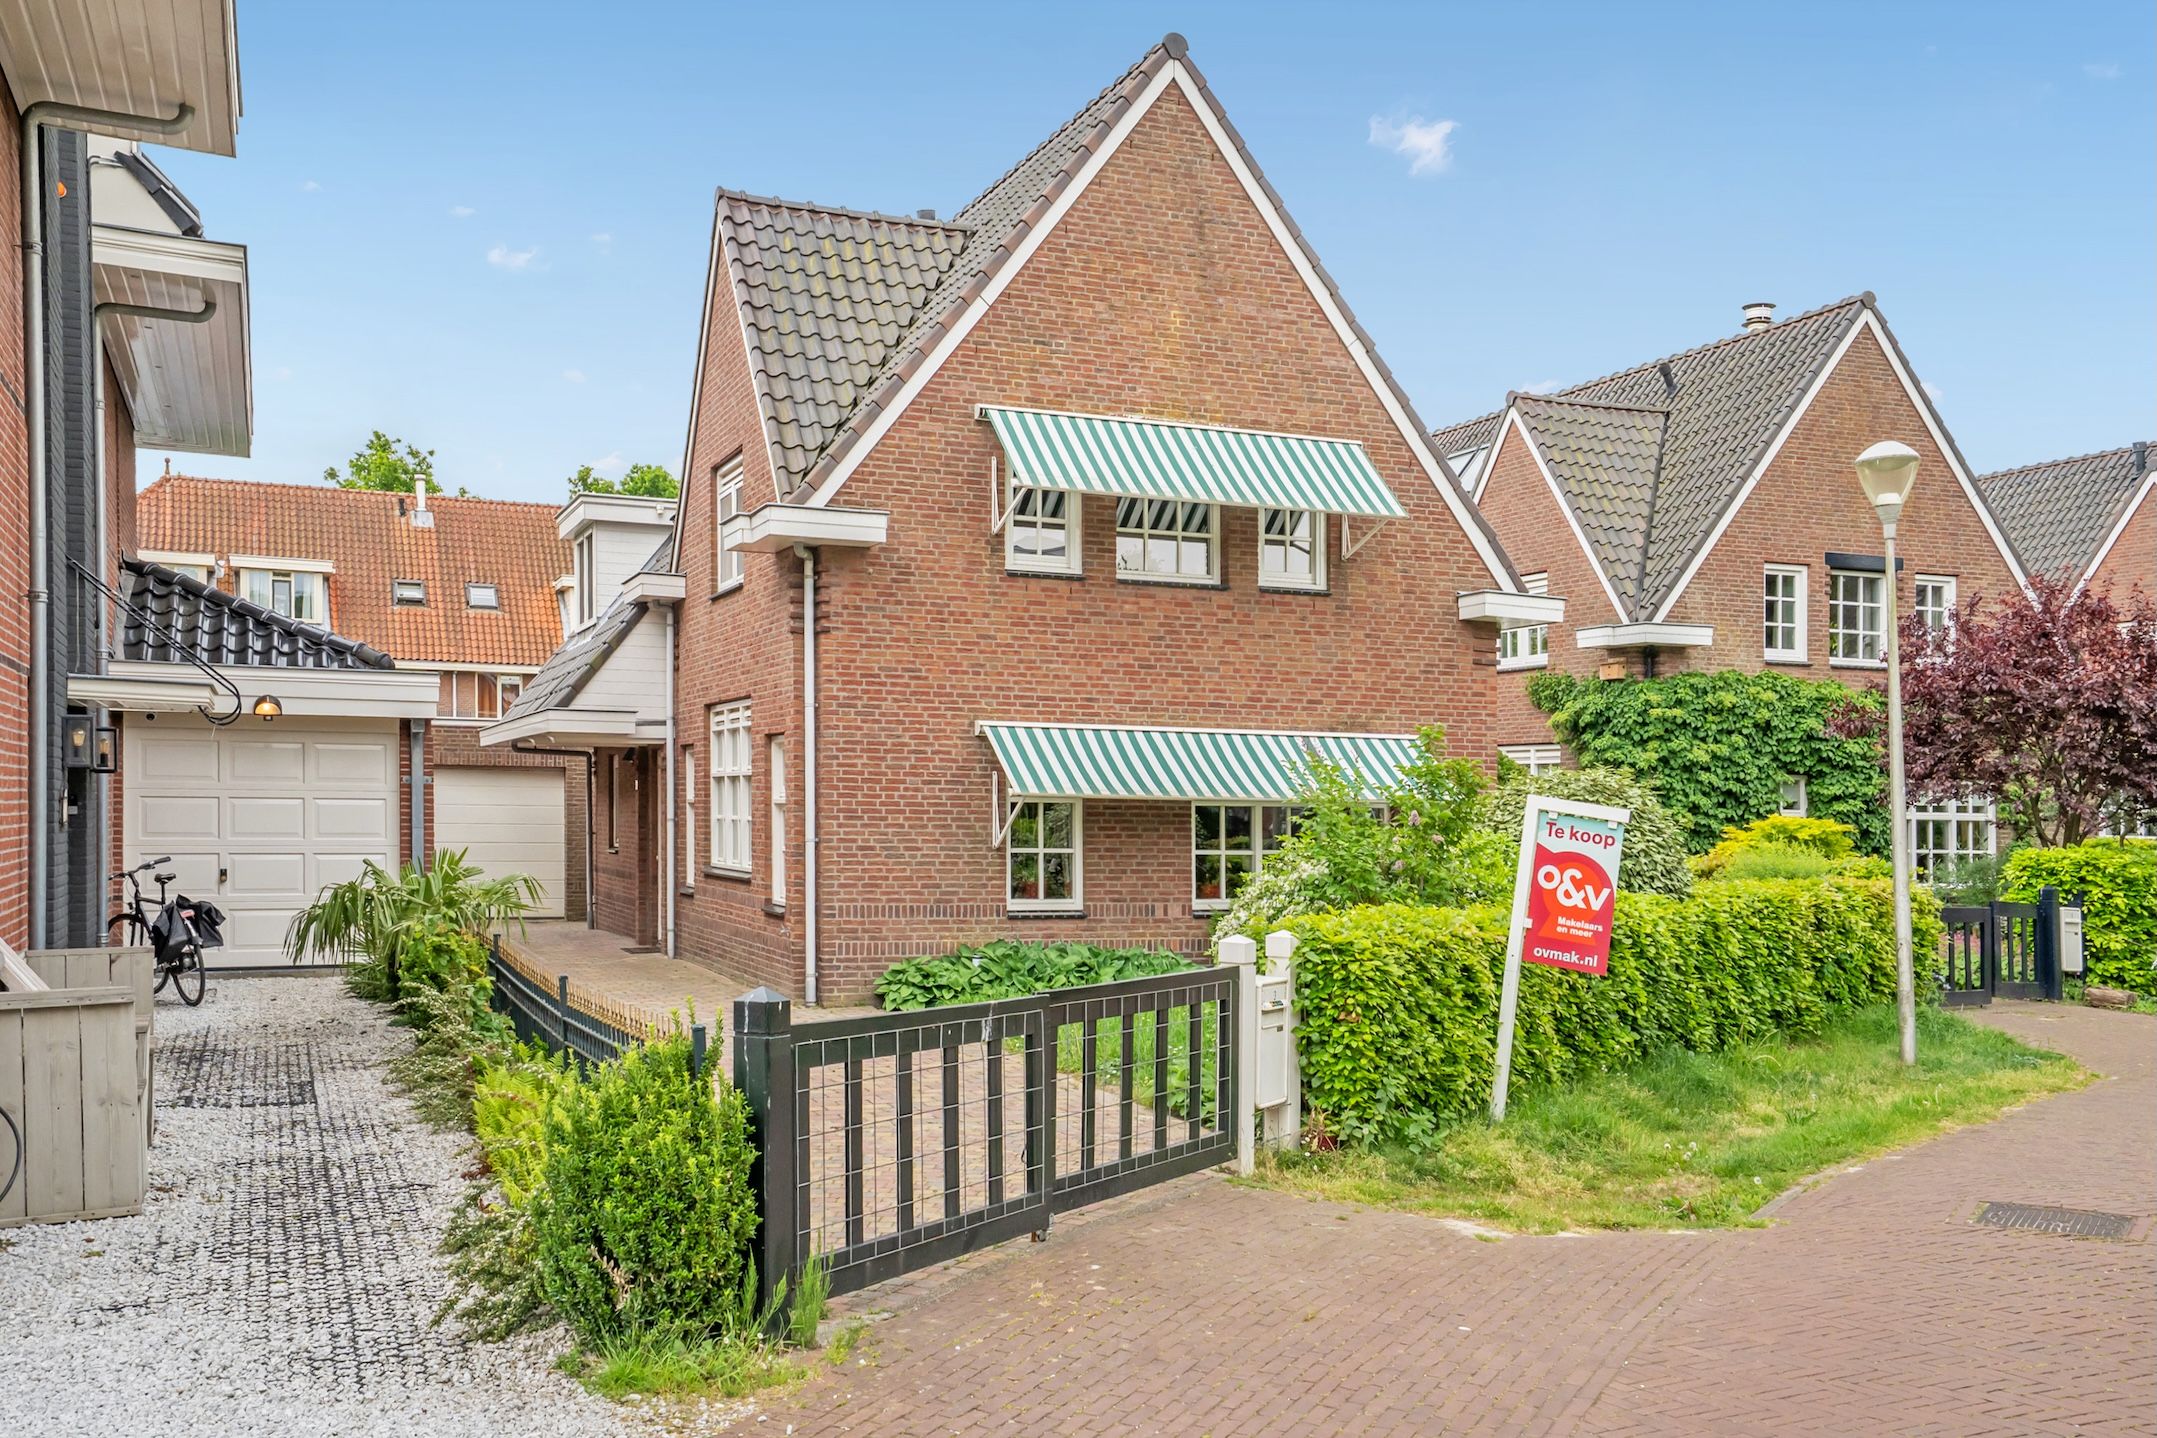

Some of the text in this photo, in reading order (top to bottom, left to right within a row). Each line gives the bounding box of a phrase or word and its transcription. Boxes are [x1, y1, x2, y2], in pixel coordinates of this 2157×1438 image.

[1546, 821, 1616, 849] Te koop
[1556, 926, 1593, 938] en meer
[1557, 916, 1603, 932] Makelaars
[1533, 947, 1598, 967] ovmak.nl
